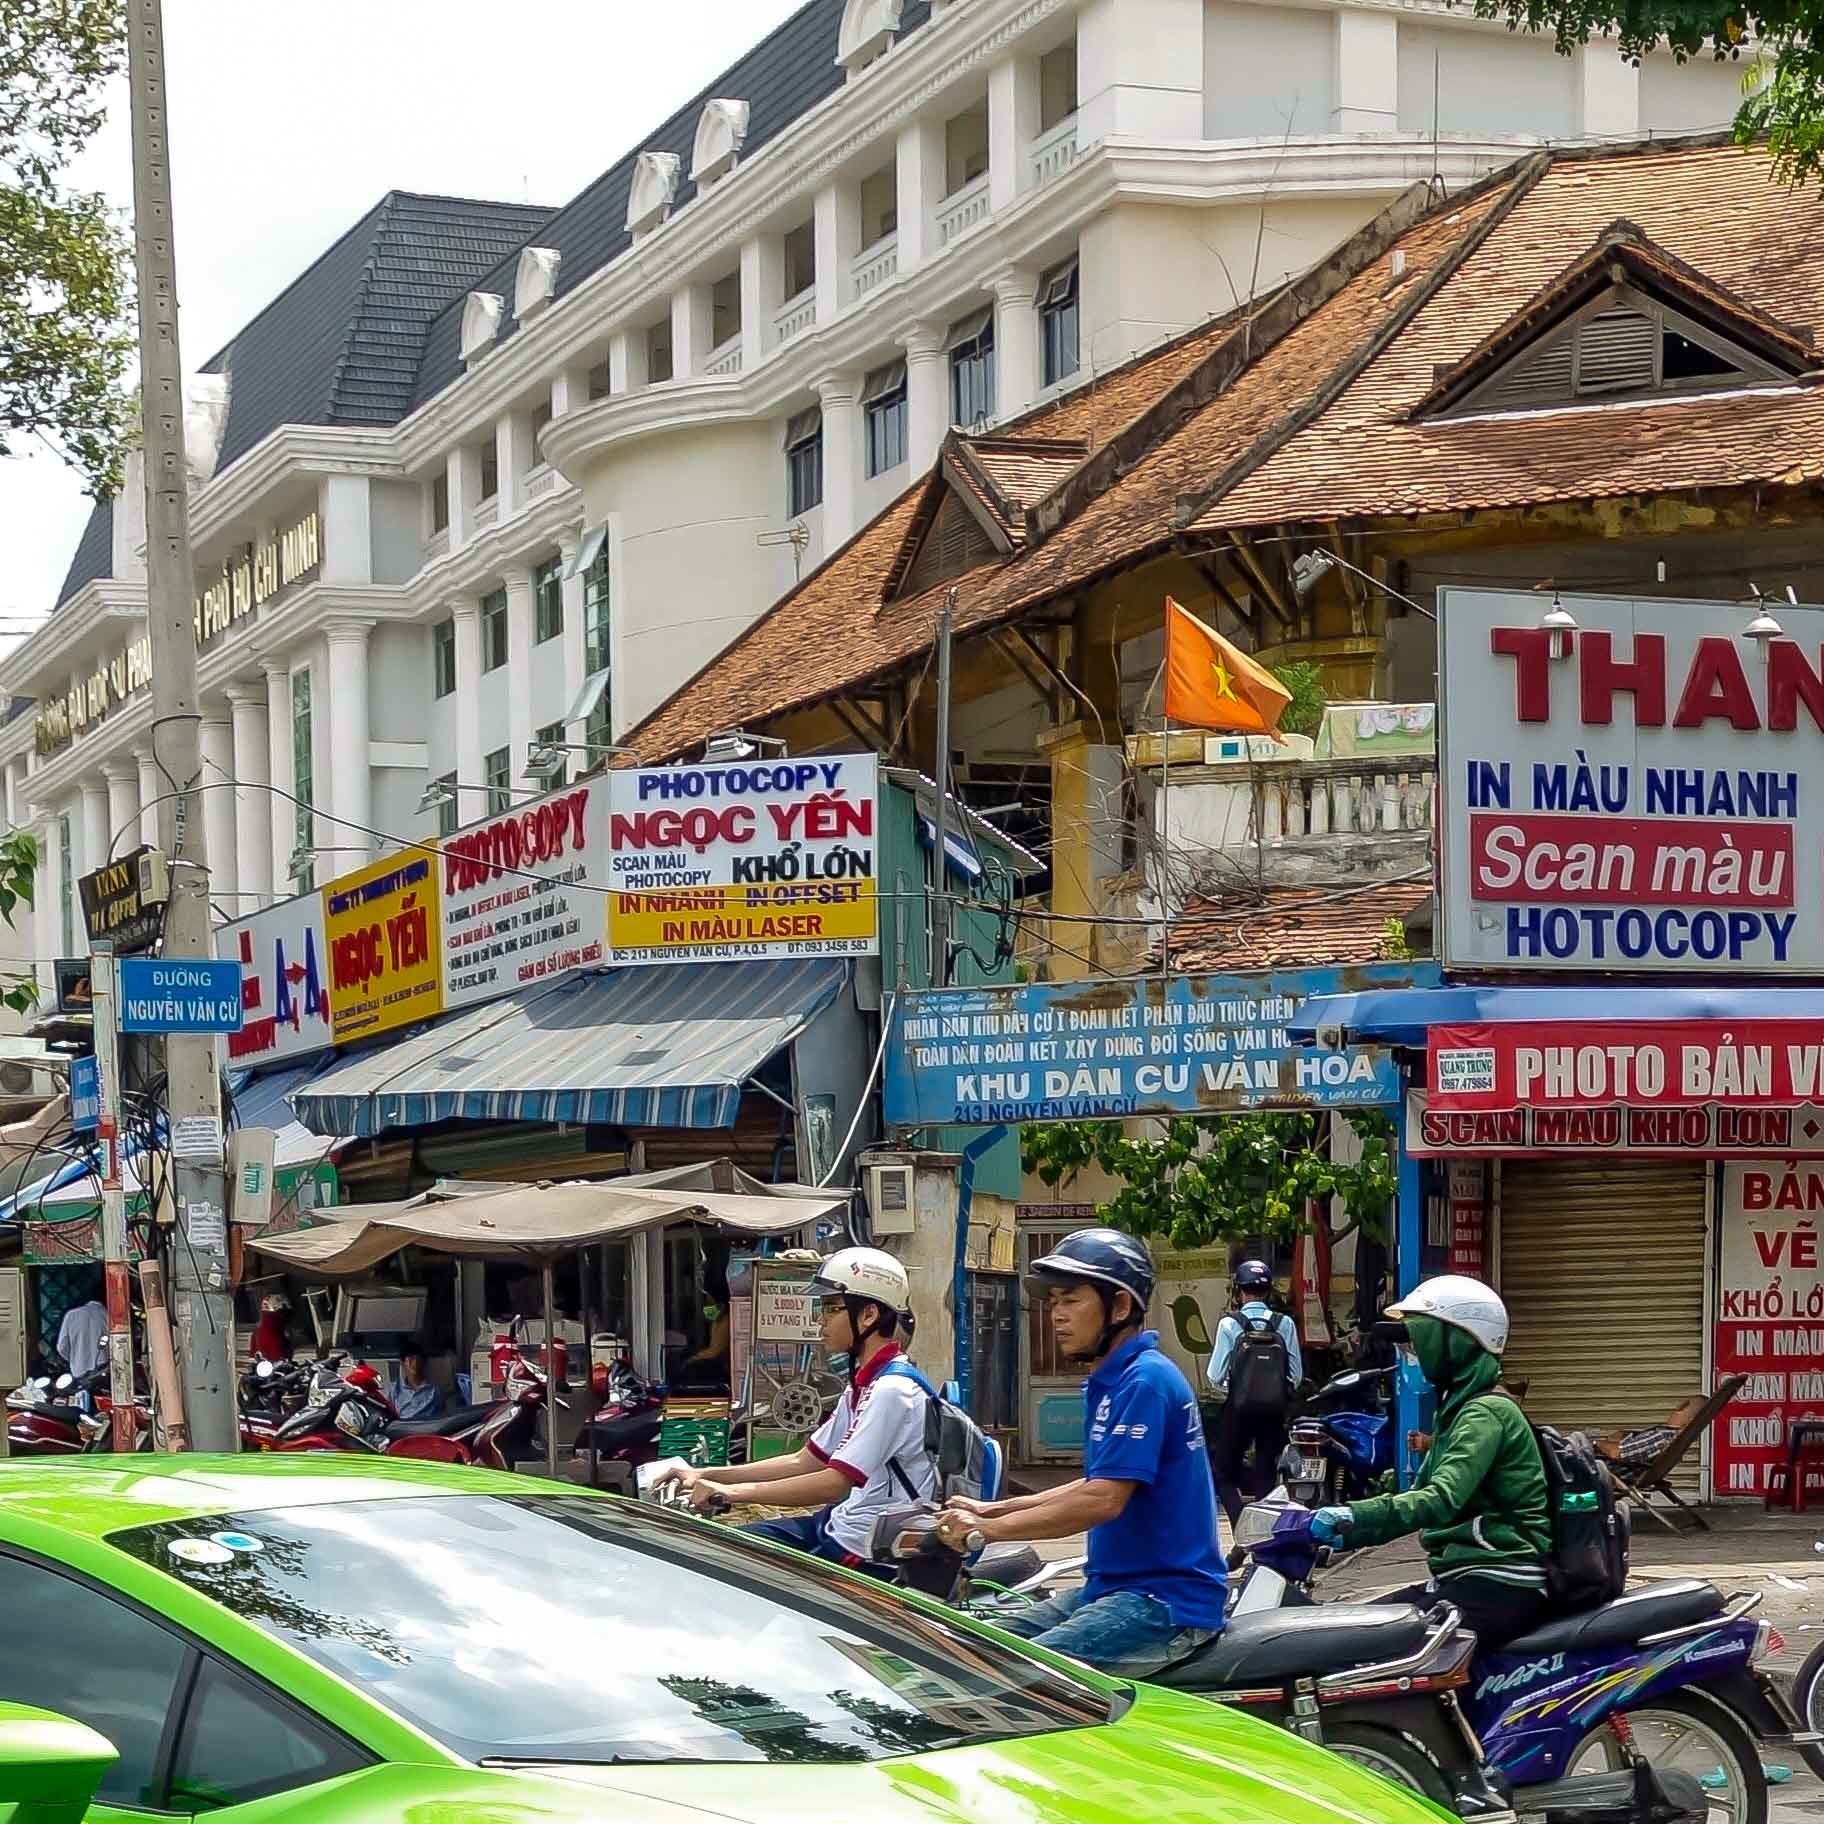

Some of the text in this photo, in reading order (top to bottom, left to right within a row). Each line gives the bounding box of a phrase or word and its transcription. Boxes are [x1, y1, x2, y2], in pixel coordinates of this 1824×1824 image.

[639, 763, 842, 800] PHOTOCOPY
[1467, 750, 1798, 818] IN MÀU NHANH
[610, 788, 872, 854] NGỌC YẾN
[444, 789, 589, 895] PHOTOCOPY
[612, 849, 687, 872] SCAN MÀU
[1479, 825, 1786, 896] Scan màu
[625, 870, 711, 889] PHOTOCOPY
[732, 841, 871, 884] KHỔ LỚN
[619, 889, 725, 914] IN NHANH
[746, 882, 862, 908] IN OFFSET
[331, 923, 383, 995] NGỌC
[387, 892, 428, 973] YẾN
[662, 914, 822, 942] IN MÀU LASER
[1506, 907, 1798, 961] HOTOCOPY
[153, 968, 212, 986] ĐƯỜNG
[128, 990, 238, 1022] NGUYỄN VĂN CỪ
[904, 1013, 937, 1041] NHÂN
[943, 1014, 969, 1037] DÂN
[973, 1014, 999, 1036] KHU
[1003, 1011, 1028, 1035] DÂN
[1034, 1006, 1054, 1033] CƯ
[1069, 1003, 1108, 1030] ĐOÀN
[1113, 1000, 1137, 1028] KẾT
[1187, 995, 1215, 1023] ĐẤU
[1218, 997, 1256, 1026] THỰC
[1261, 994, 1294, 1024] HIỆN
[984, 1038, 1024, 1064] ĐOÀN
[1030, 1035, 1058, 1061] KẾT
[1065, 1035, 1096, 1060] XÂY
[1105, 1033, 1143, 1061] DỰNG
[1151, 1028, 1177, 1055] ĐỜI
[1183, 1024, 1226, 1053] SỐNG
[1233, 1023, 1265, 1050] VĂN
[957, 1072, 1029, 1101] KHU
[1045, 1063, 1121, 1098] DÂN
[1135, 1057, 1191, 1094] CƯ
[1203, 1054, 1278, 1090] VĂN
[1516, 1046, 1666, 1099] PHOTO
[1681, 1032, 1772, 1097] BẢN
[954, 1104, 983, 1122] 213
[1422, 1108, 1525, 1146] SCAN
[1754, 1219, 1818, 1269] VẼ
[1724, 1275, 1784, 1318] KHỔ
[1736, 1326, 1824, 1356] IN MÀU
[1731, 1407, 1783, 1447] KHỔ
[1729, 1463, 1755, 1489] IN
[1476, 1660, 1549, 1699] MAX
